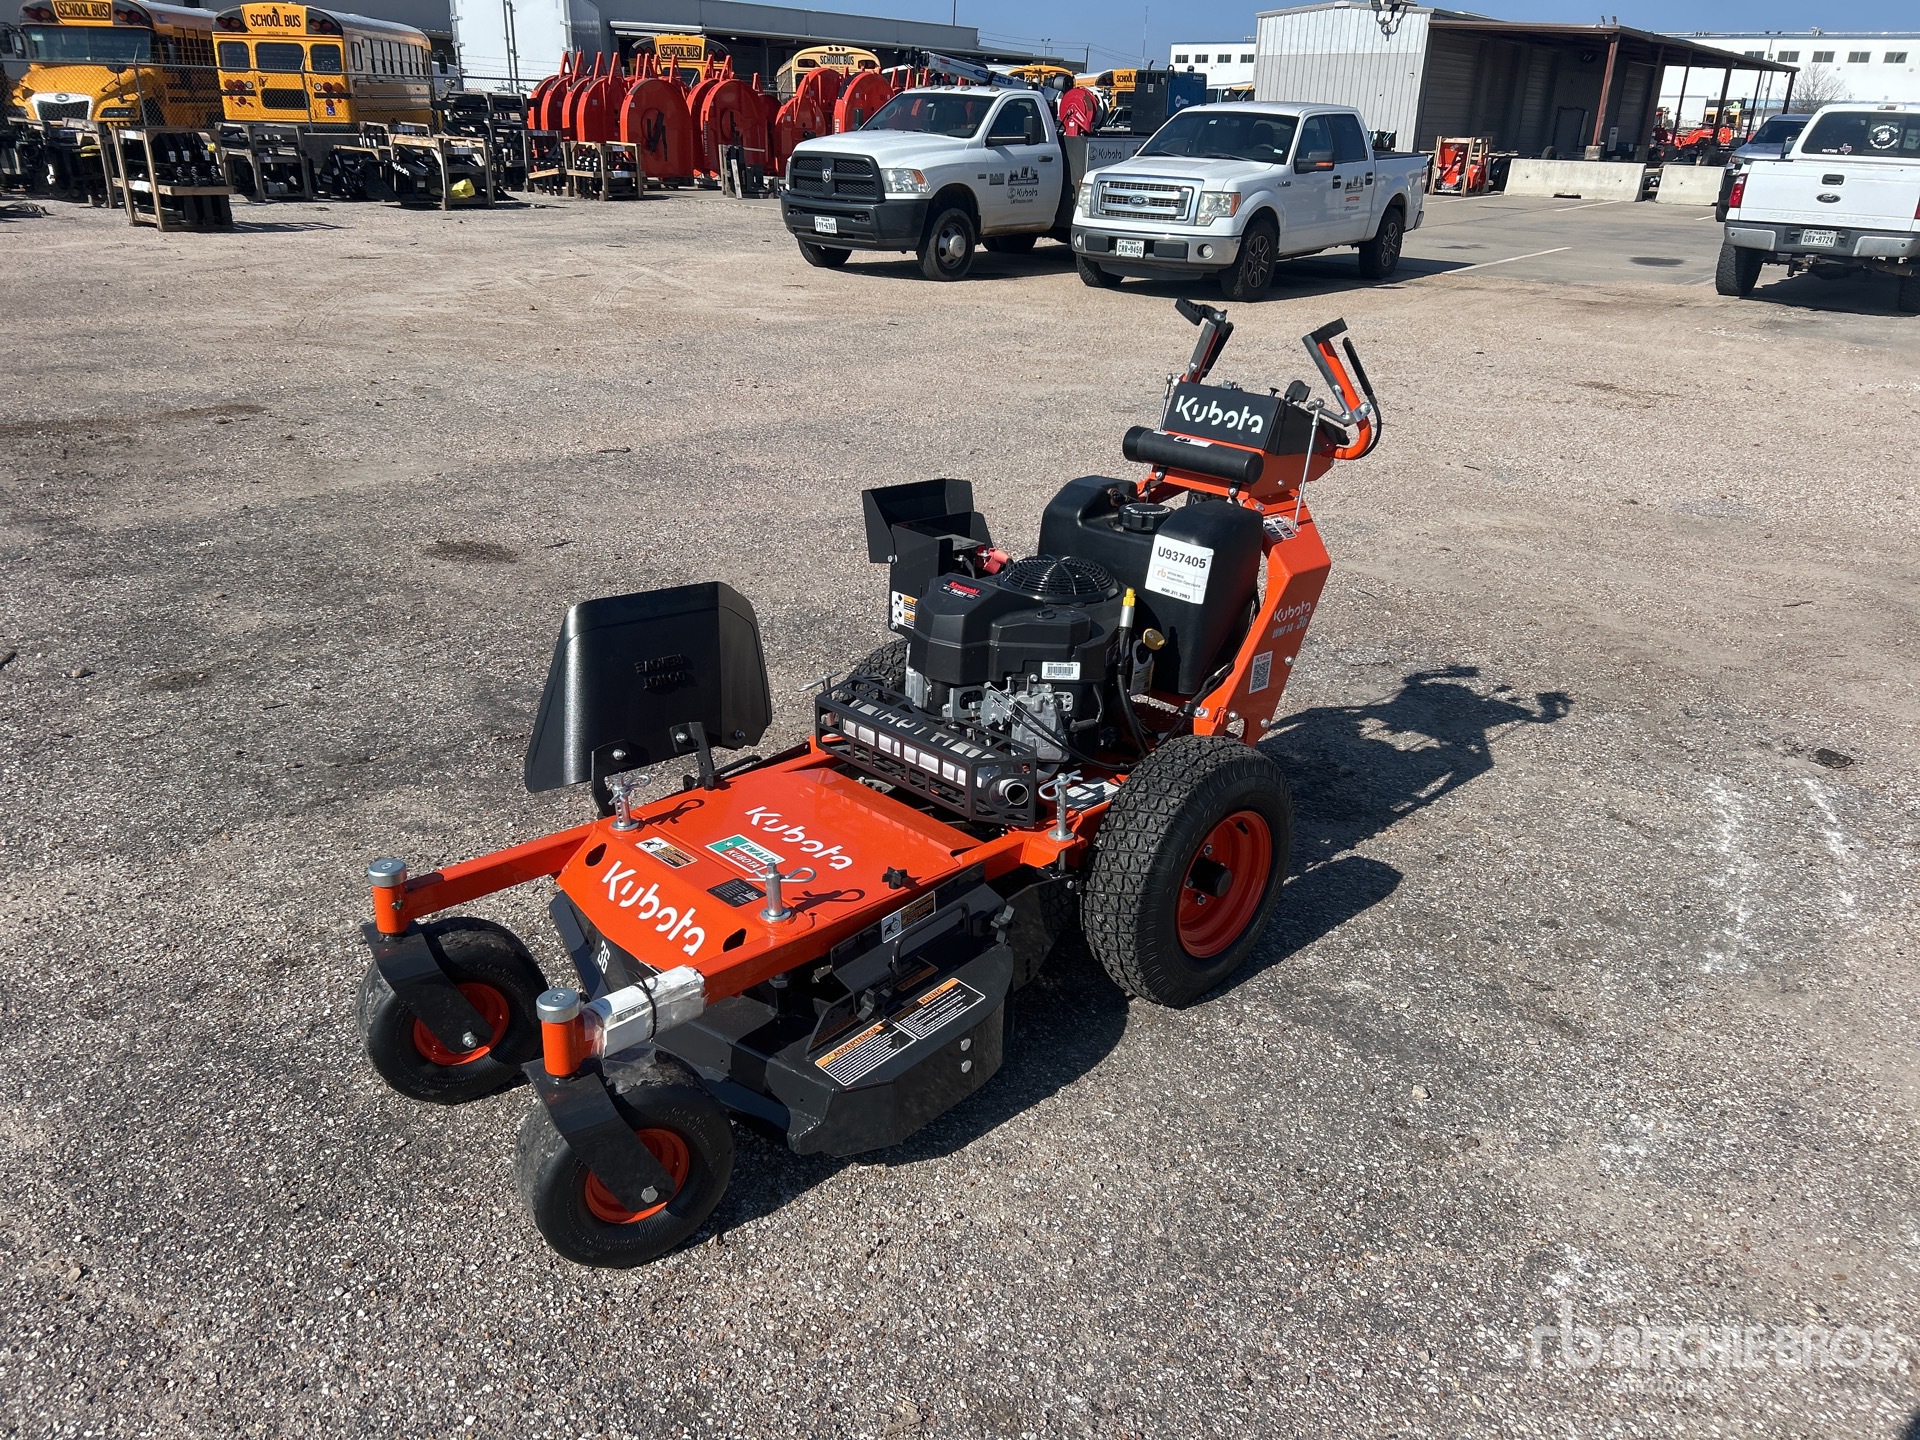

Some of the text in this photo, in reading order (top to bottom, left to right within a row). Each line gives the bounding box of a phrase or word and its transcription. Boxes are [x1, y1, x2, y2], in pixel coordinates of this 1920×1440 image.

[59, 2, 109, 17] SCHOOL BUS
[250, 13, 301, 28] SCHOOL BUS
[661, 45, 699, 57] SCHOOL BUS
[820, 55, 855, 66] SCHOOL BUS
[1116, 74, 1133, 83] SCHOOL
[1098, 148, 1122, 160] Kubota
[1016, 187, 1039, 197] Kubota
[1174, 394, 1265, 434] Kubota
[1157, 546, 1208, 569] U937405
[1273, 600, 1311, 622] Kubota
[745, 806, 853, 871] Kubota
[725, 849, 761, 869] KUBOTA
[601, 860, 706, 957] Kubota
[597, 940, 611, 975] 36
[912, 987, 945, 1011] WARNING
[832, 1026, 881, 1057] ADVERTENCIA
